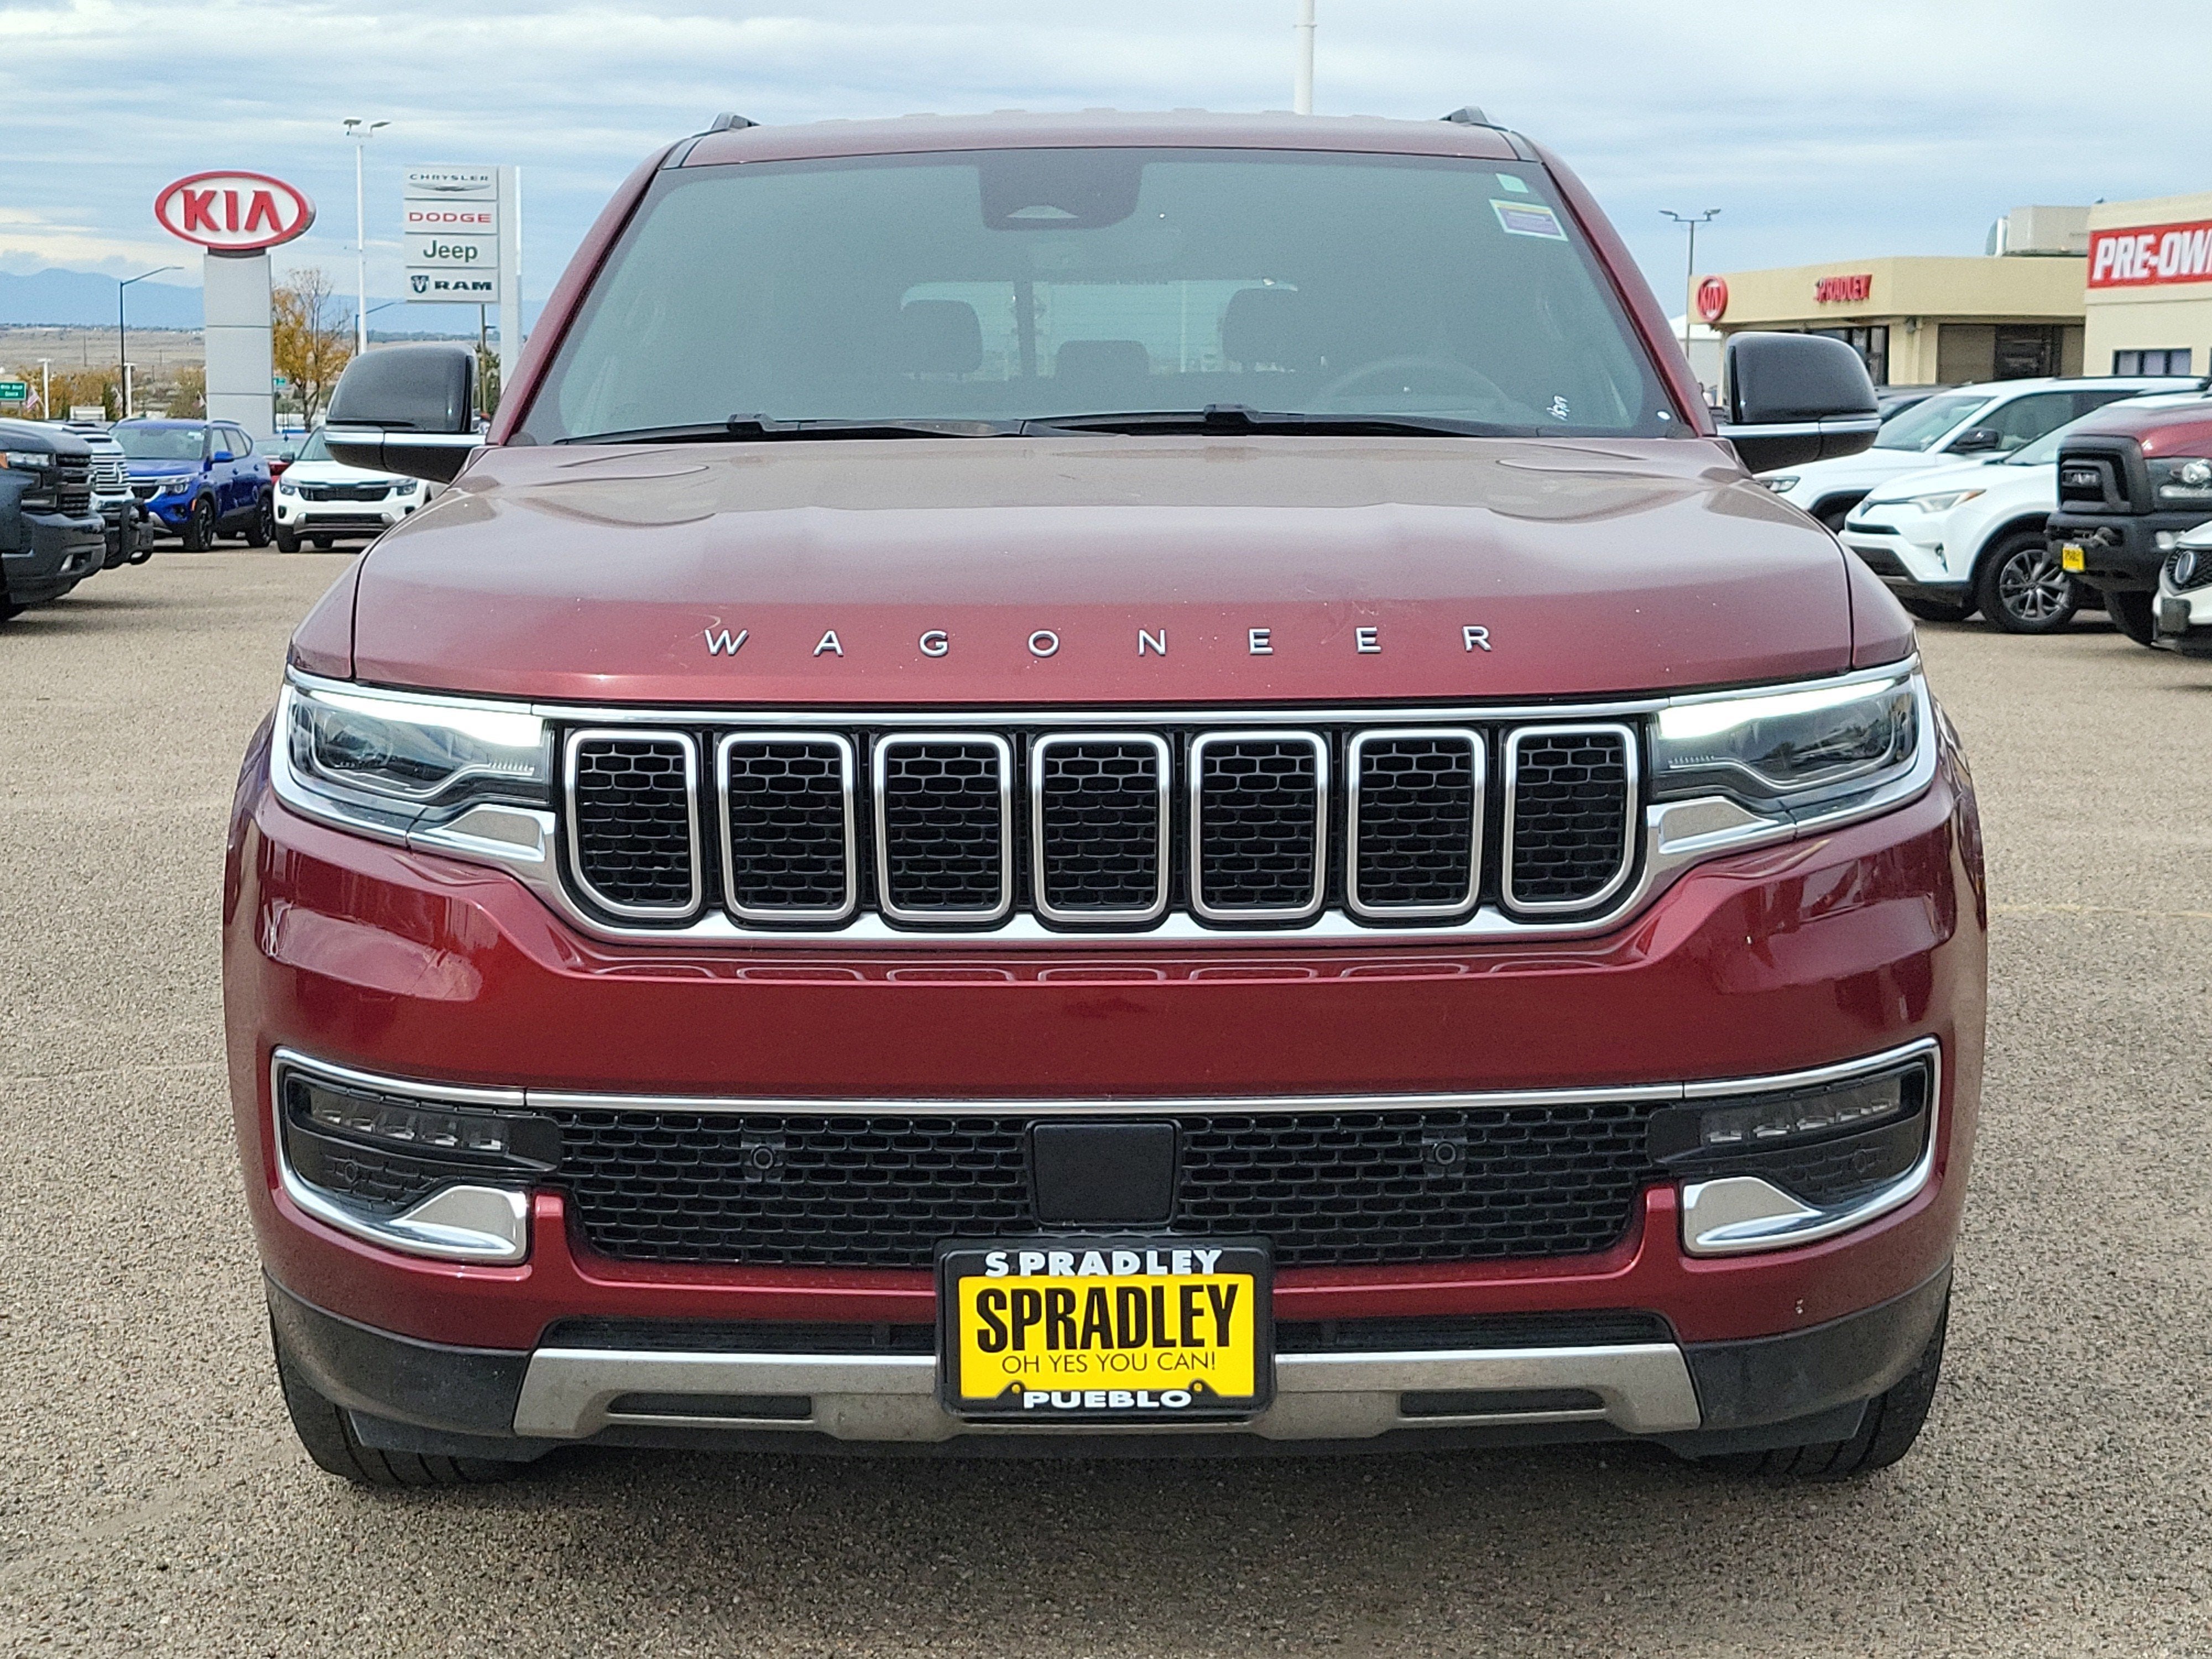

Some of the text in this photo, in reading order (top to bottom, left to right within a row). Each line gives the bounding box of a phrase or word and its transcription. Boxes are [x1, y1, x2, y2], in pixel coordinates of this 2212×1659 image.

[181, 189, 283, 232] KIA
[409, 212, 492, 223] DODGE
[423, 240, 478, 263] Jeep
[435, 280, 493, 290] RAM
[705, 625, 1492, 657] WAGONEER
[975, 1283, 1239, 1353] SPRADLEY
[1001, 1351, 1216, 1374] OH YES YOU CAN!
[1023, 1390, 1192, 1409] PUEBLO
